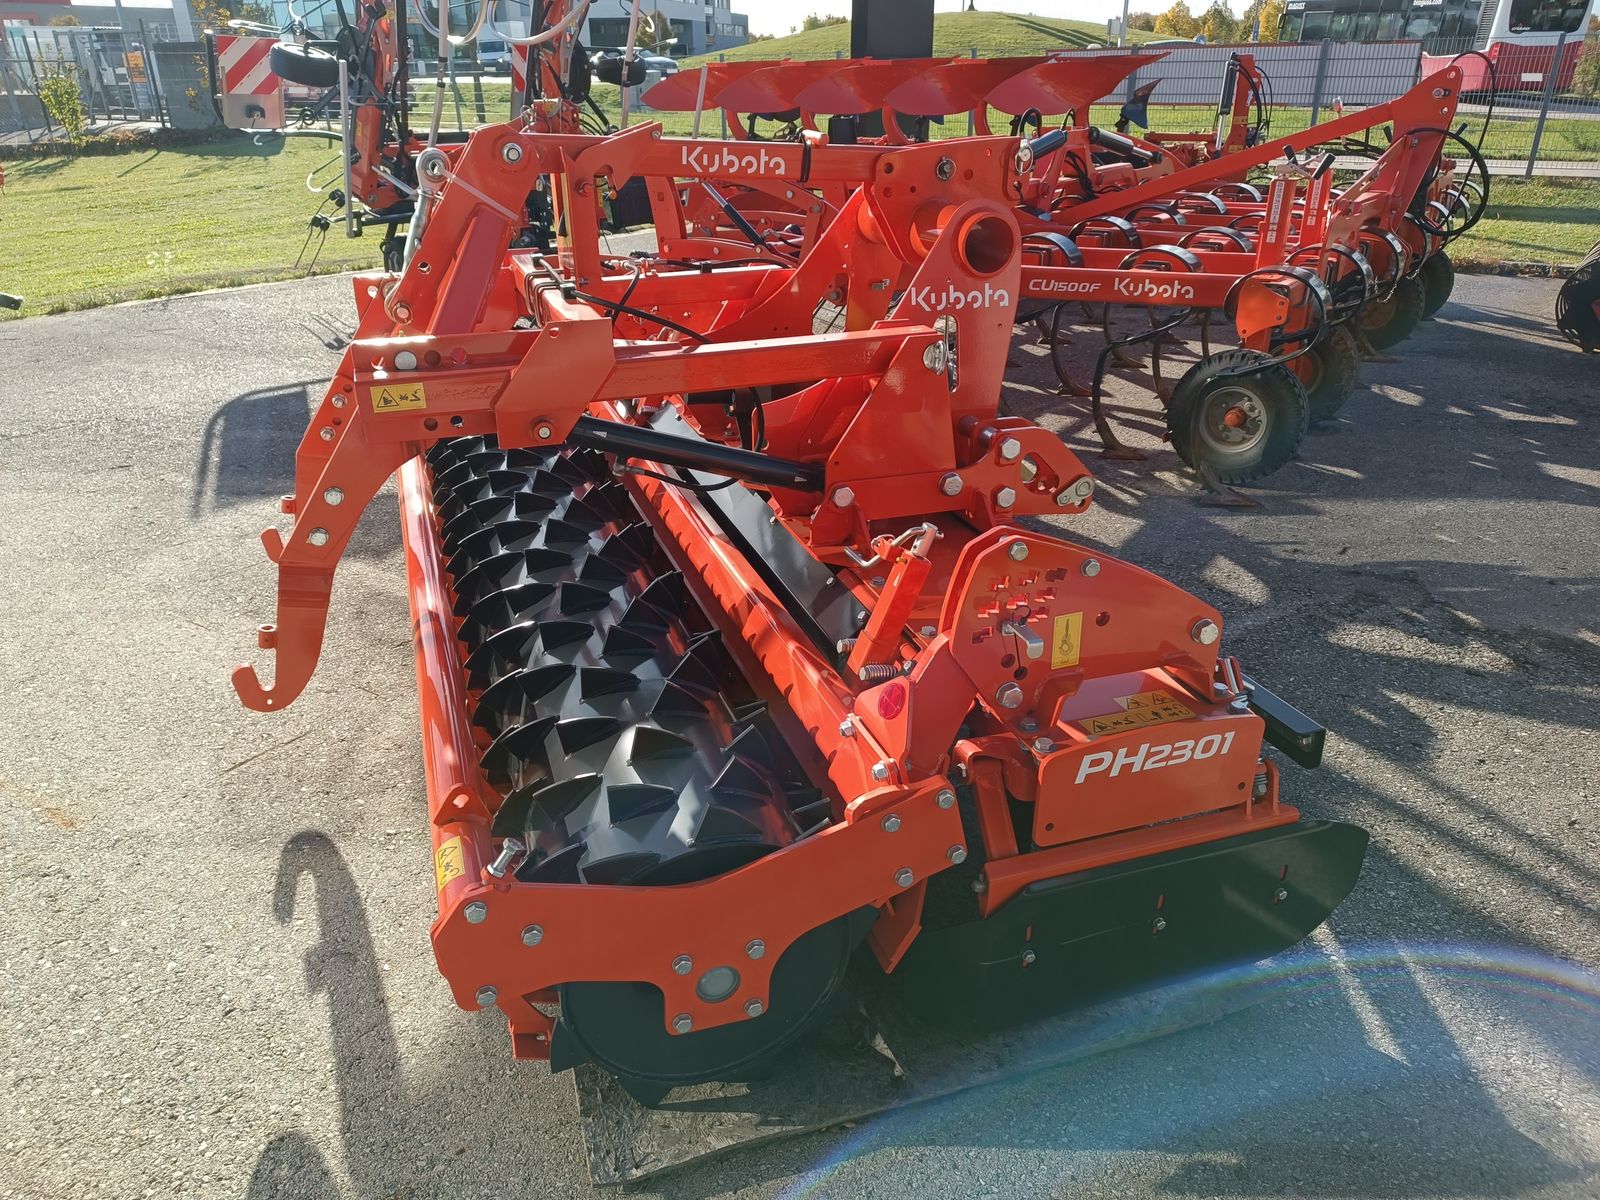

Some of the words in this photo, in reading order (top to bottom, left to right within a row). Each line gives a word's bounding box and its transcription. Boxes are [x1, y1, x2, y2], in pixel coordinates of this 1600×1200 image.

[682, 145, 786, 175] Kubota
[911, 282, 1009, 312] Kubota
[1028, 279, 1102, 293] CU1500F
[1114, 277, 1195, 299] Kubota
[1074, 731, 1236, 784] PH2301
